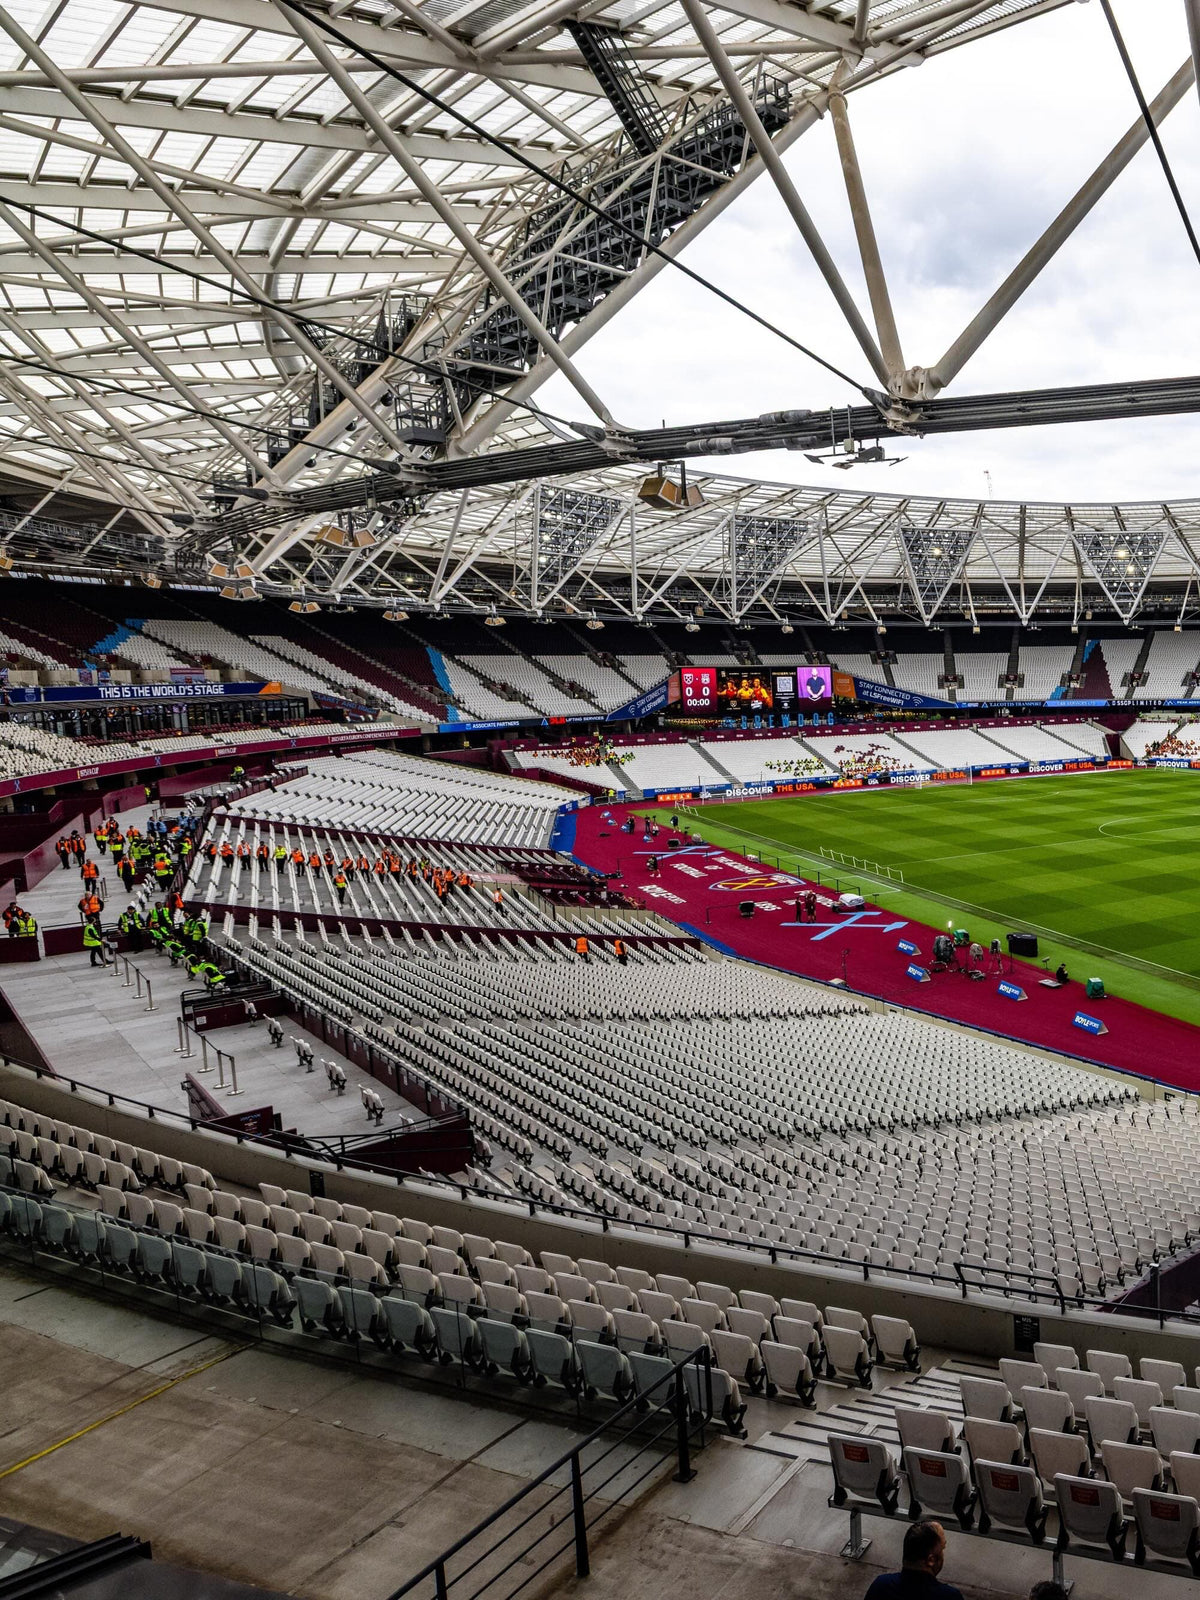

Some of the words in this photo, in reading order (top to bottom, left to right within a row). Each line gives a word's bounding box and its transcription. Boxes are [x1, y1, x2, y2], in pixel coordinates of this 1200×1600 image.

[99, 687, 120, 698] THIS
[121, 687, 131, 697] IS
[131, 686, 151, 697] THE
[151, 685, 193, 696] WORLD'S
[195, 684, 225, 695] STAGE
[685, 687, 693, 697] 0
[702, 686, 710, 696] 0
[859, 681, 874, 690] STAY
[874, 686, 910, 700] CONNECTED
[687, 698, 710, 707] 00:00
[1029, 764, 1063, 773] DISCOVER
[1079, 761, 1094, 769] USA.
[890, 774, 931, 784] DISCOVER
[949, 771, 967, 779] USA.
[726, 786, 773, 797] DISCOVER
[776, 785, 794, 793] THE
